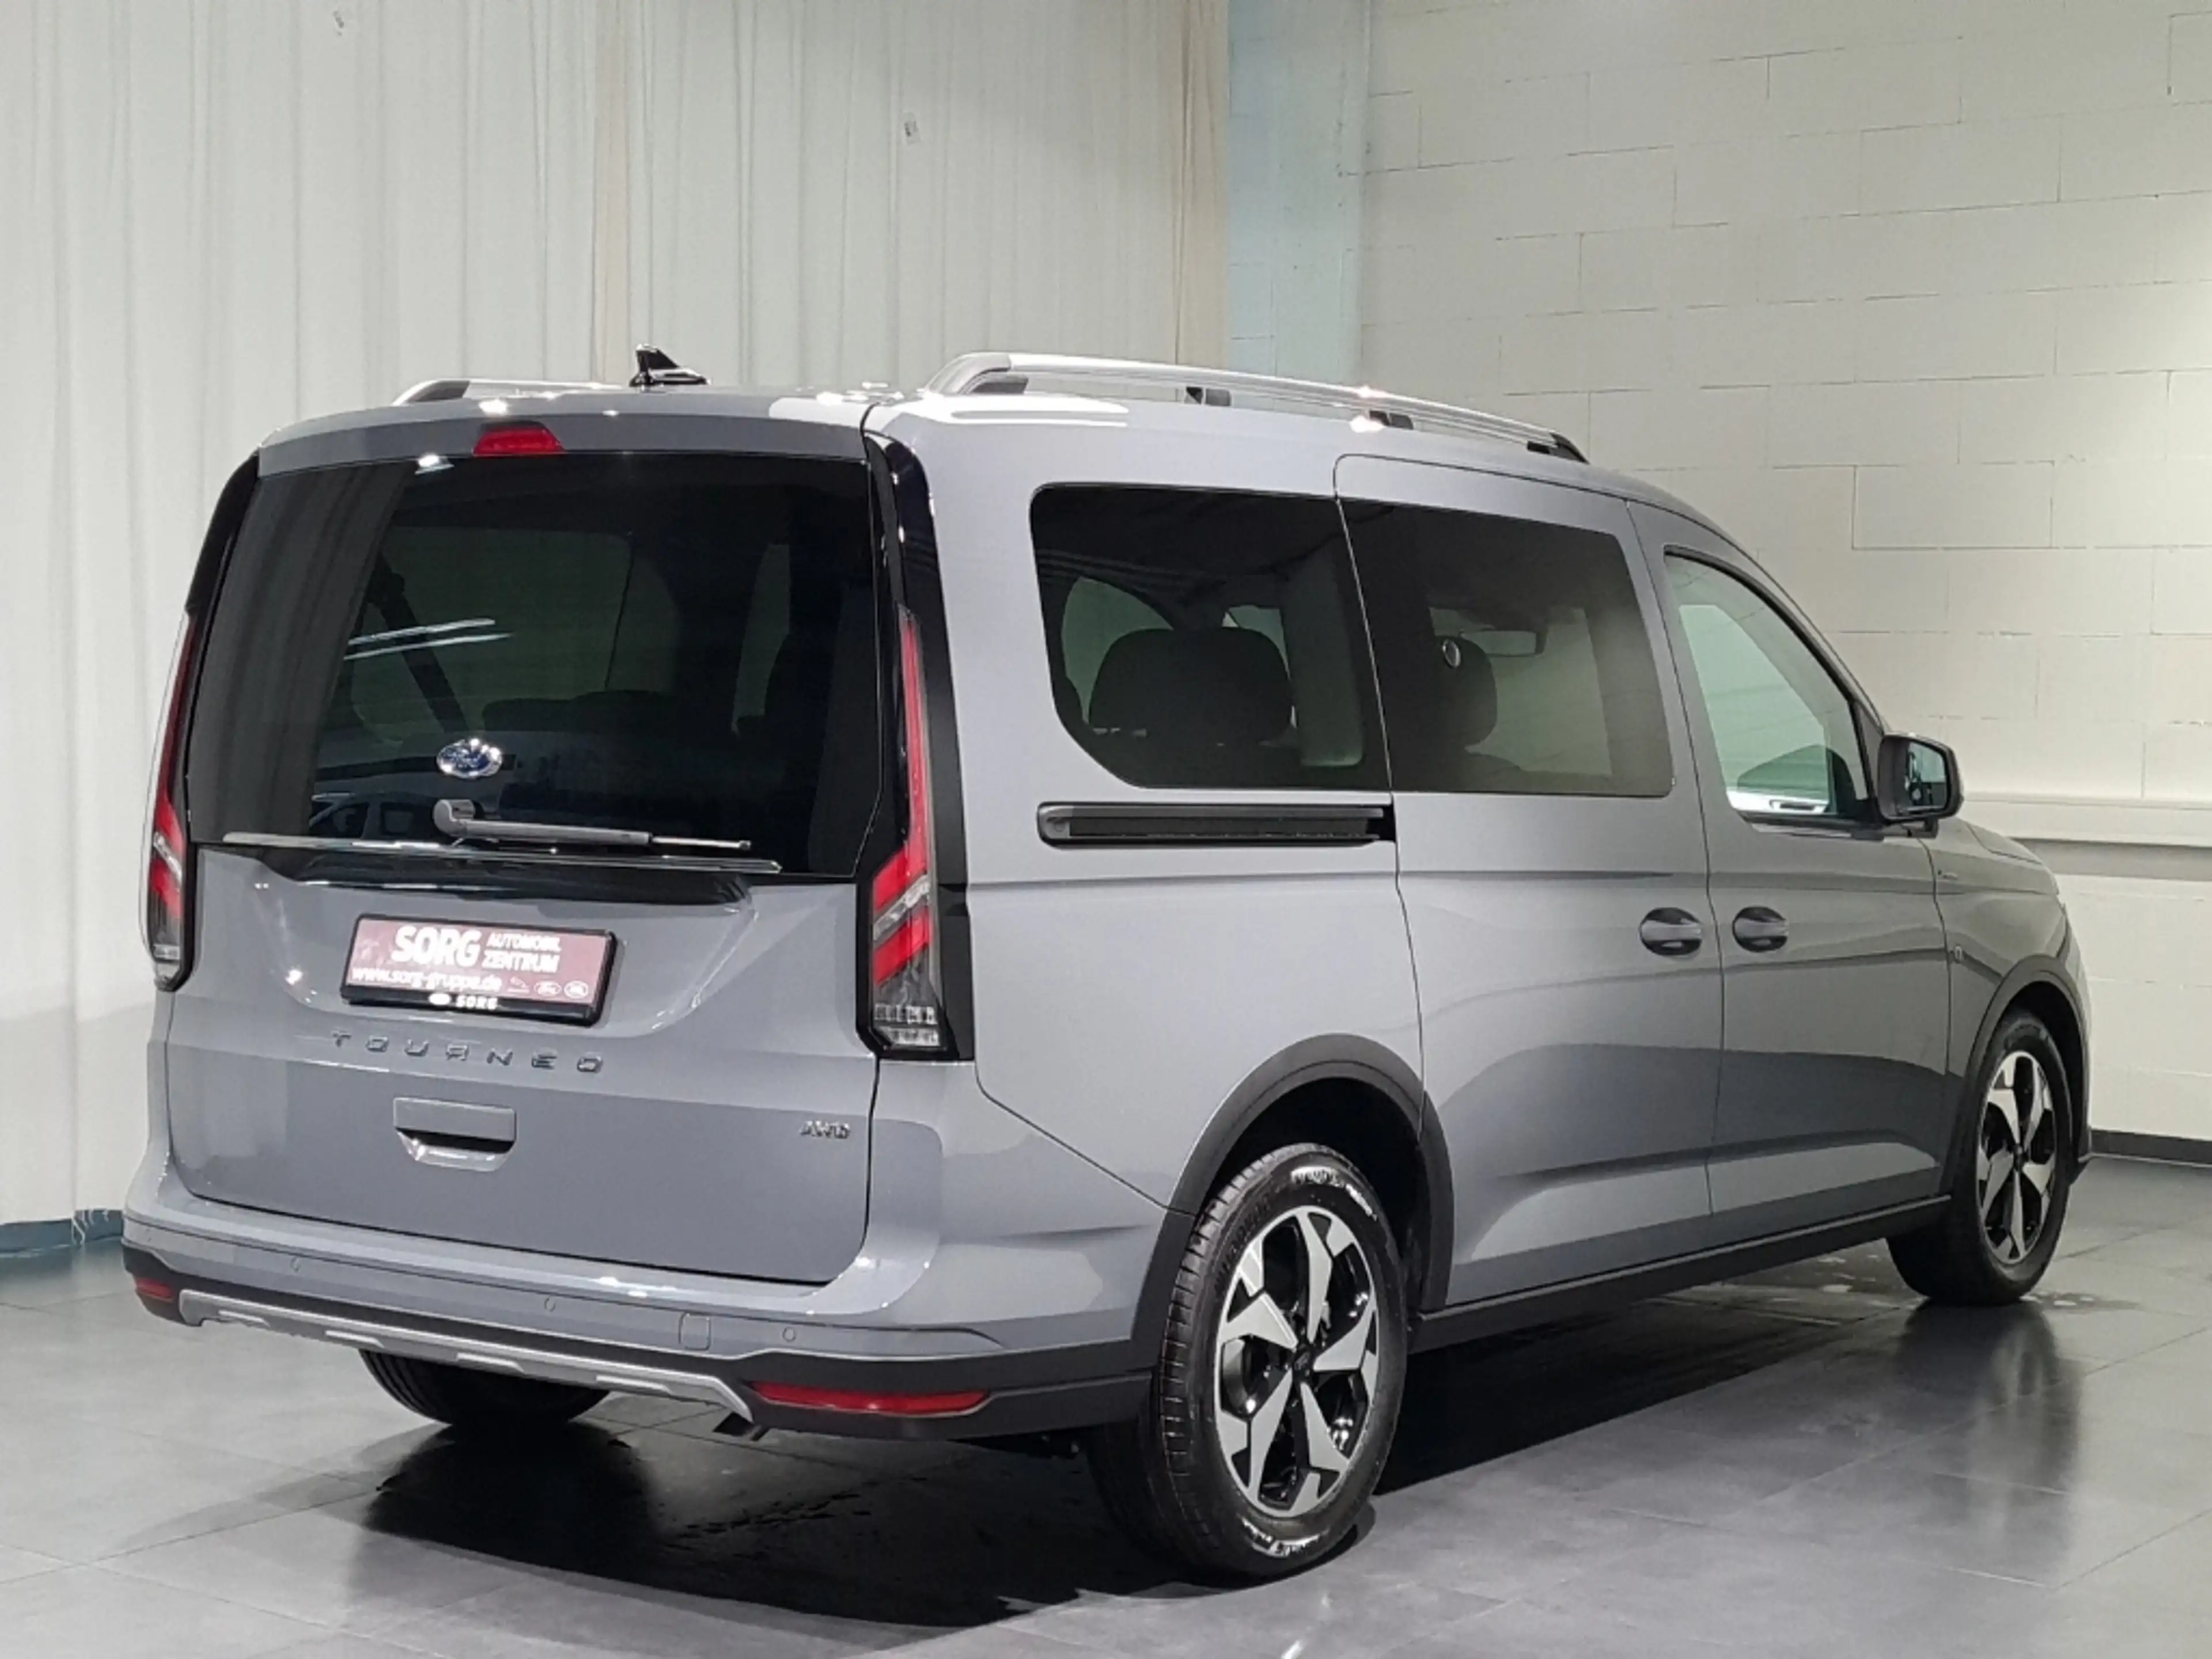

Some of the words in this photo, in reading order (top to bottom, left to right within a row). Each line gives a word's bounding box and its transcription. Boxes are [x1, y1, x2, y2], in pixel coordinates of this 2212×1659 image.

[392, 925, 482, 967] SORG
[486, 932, 562, 952] AUTOMOBIL
[482, 950, 559, 972] ZENTRUM
[456, 995, 498, 1010] SORG
[332, 1030, 603, 1073] TOURNEO
[799, 1120, 851, 1139] AWD
